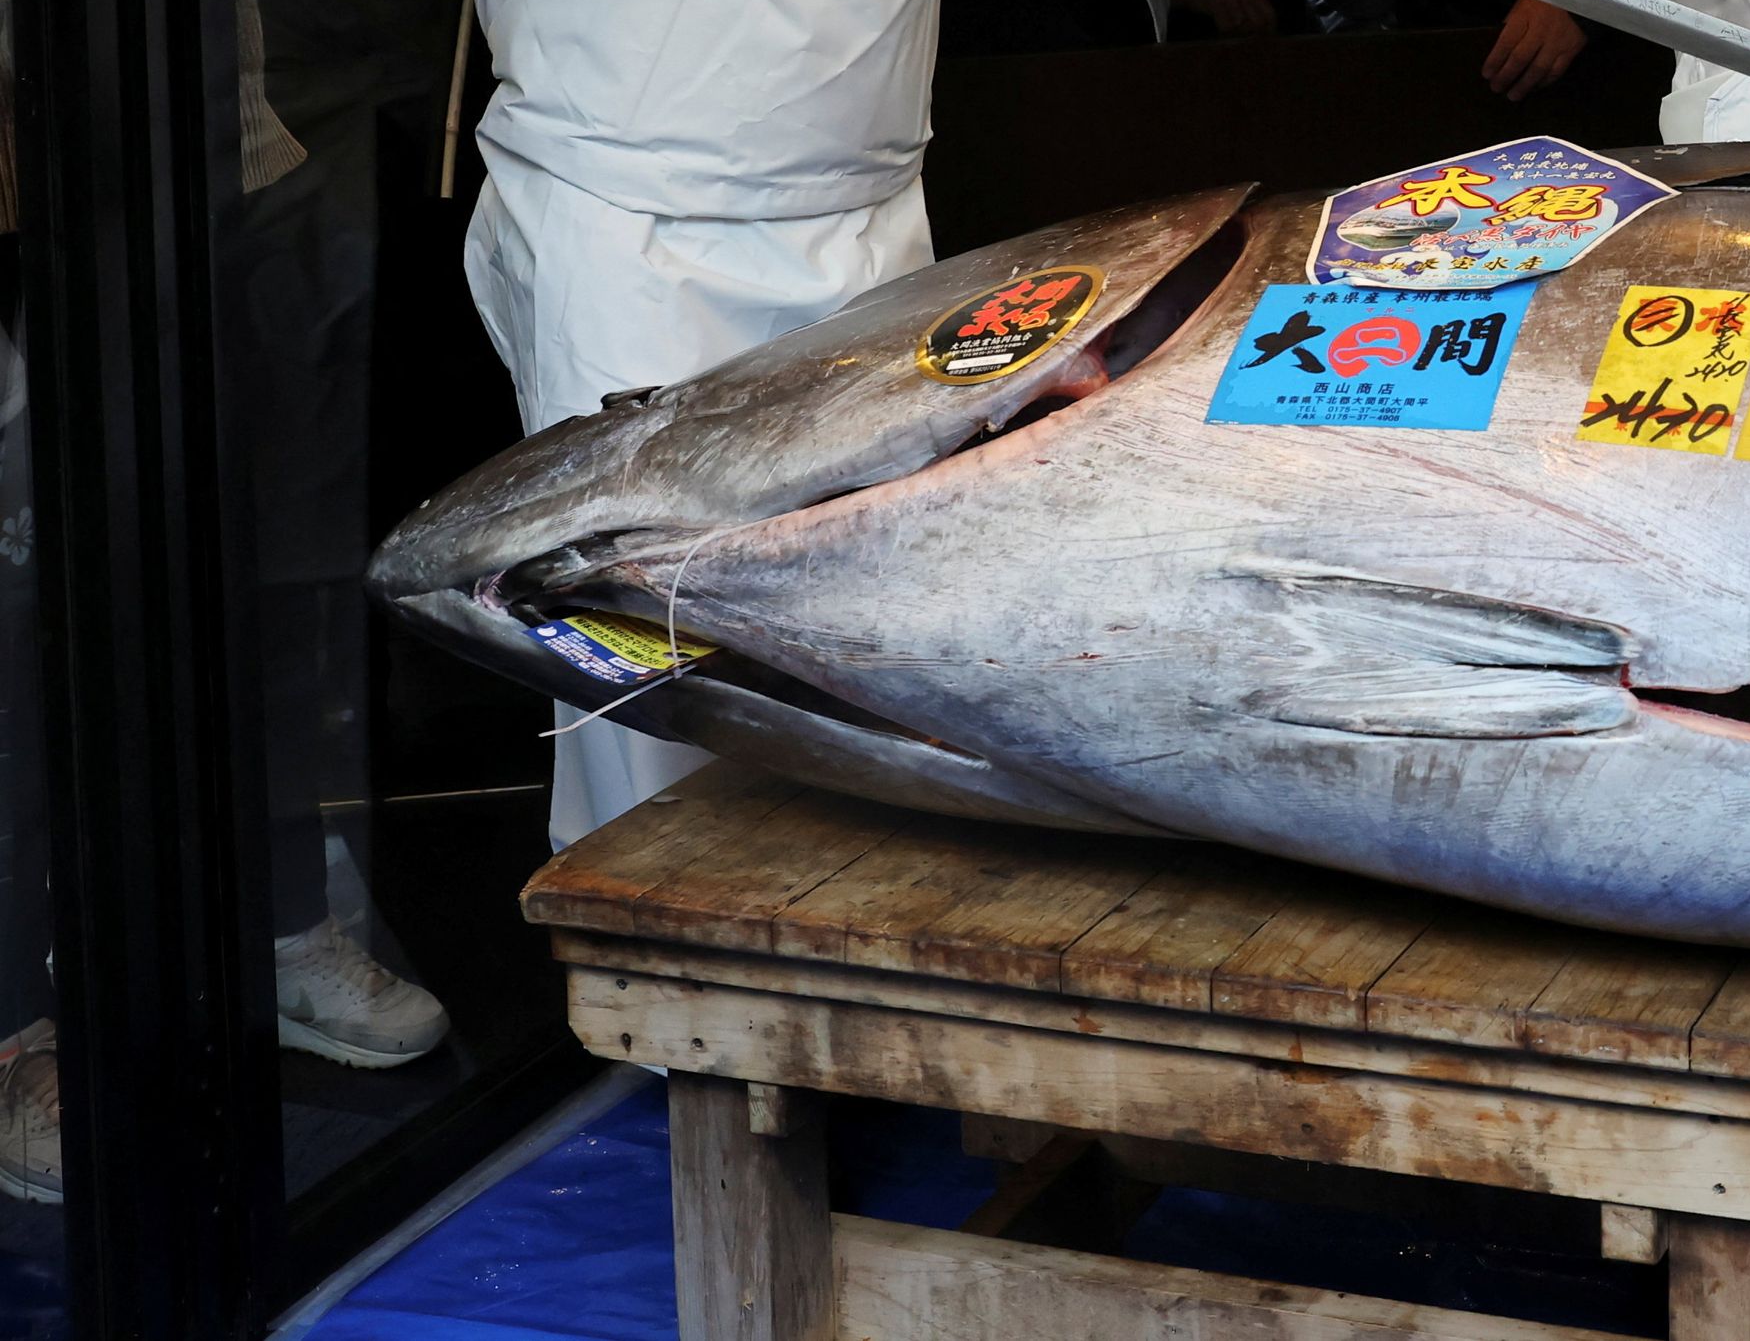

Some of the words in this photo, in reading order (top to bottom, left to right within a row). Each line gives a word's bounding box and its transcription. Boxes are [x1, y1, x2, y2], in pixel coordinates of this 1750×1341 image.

[1301, 291, 1380, 305] 青森県産
[1312, 382, 1396, 395] 西山商店
